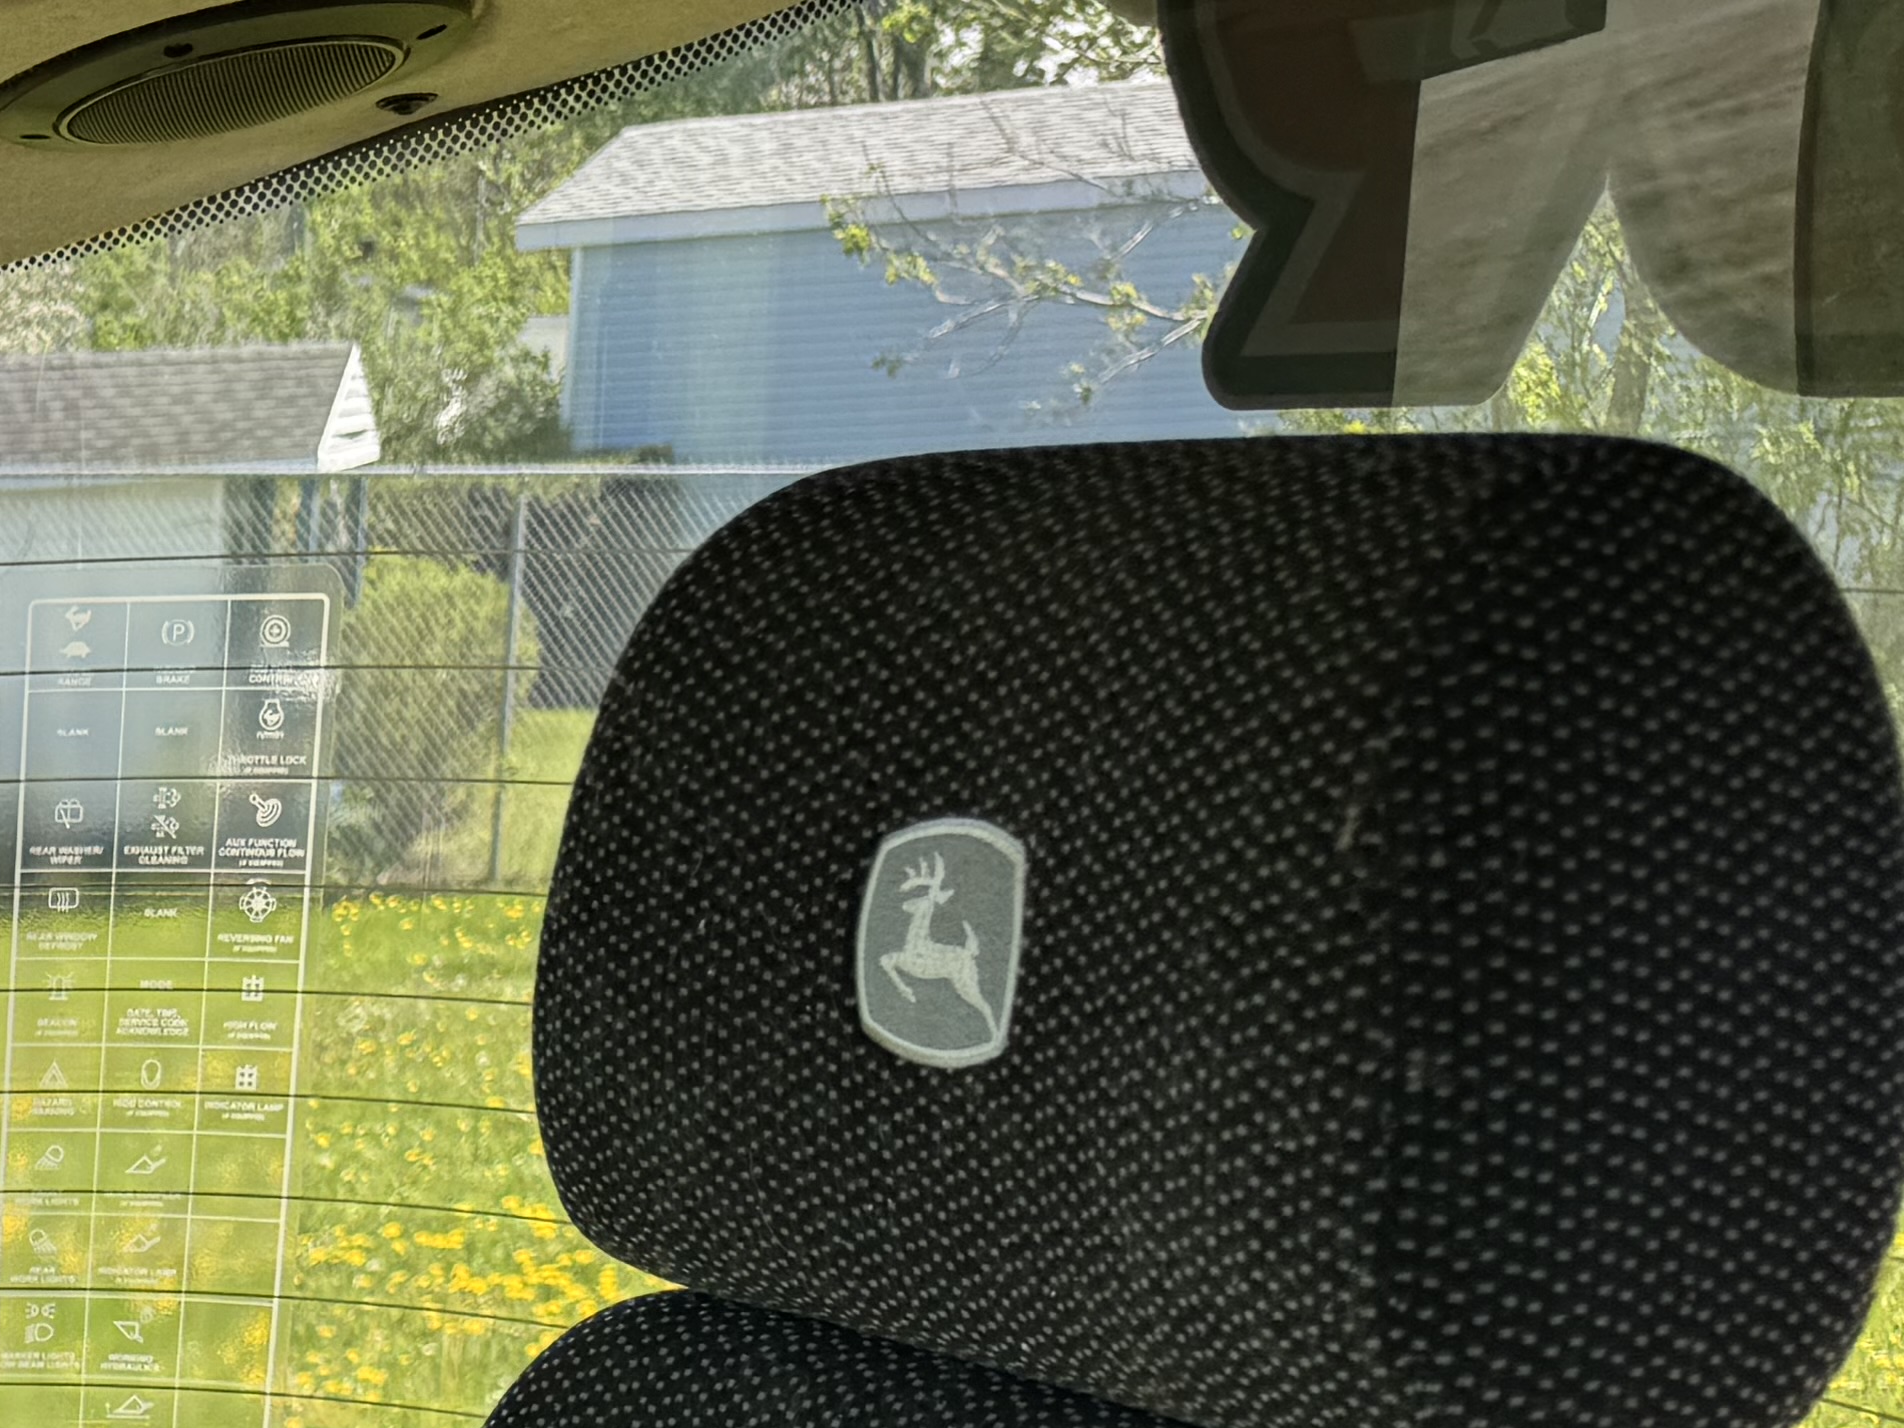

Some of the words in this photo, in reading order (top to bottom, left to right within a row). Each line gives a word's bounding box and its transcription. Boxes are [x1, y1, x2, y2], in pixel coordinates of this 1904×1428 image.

[155, 675, 191, 685] BRAKE
[154, 727, 189, 737] BLANK
[279, 755, 307, 765] LOCK
[123, 845, 170, 856] EXHAUST
